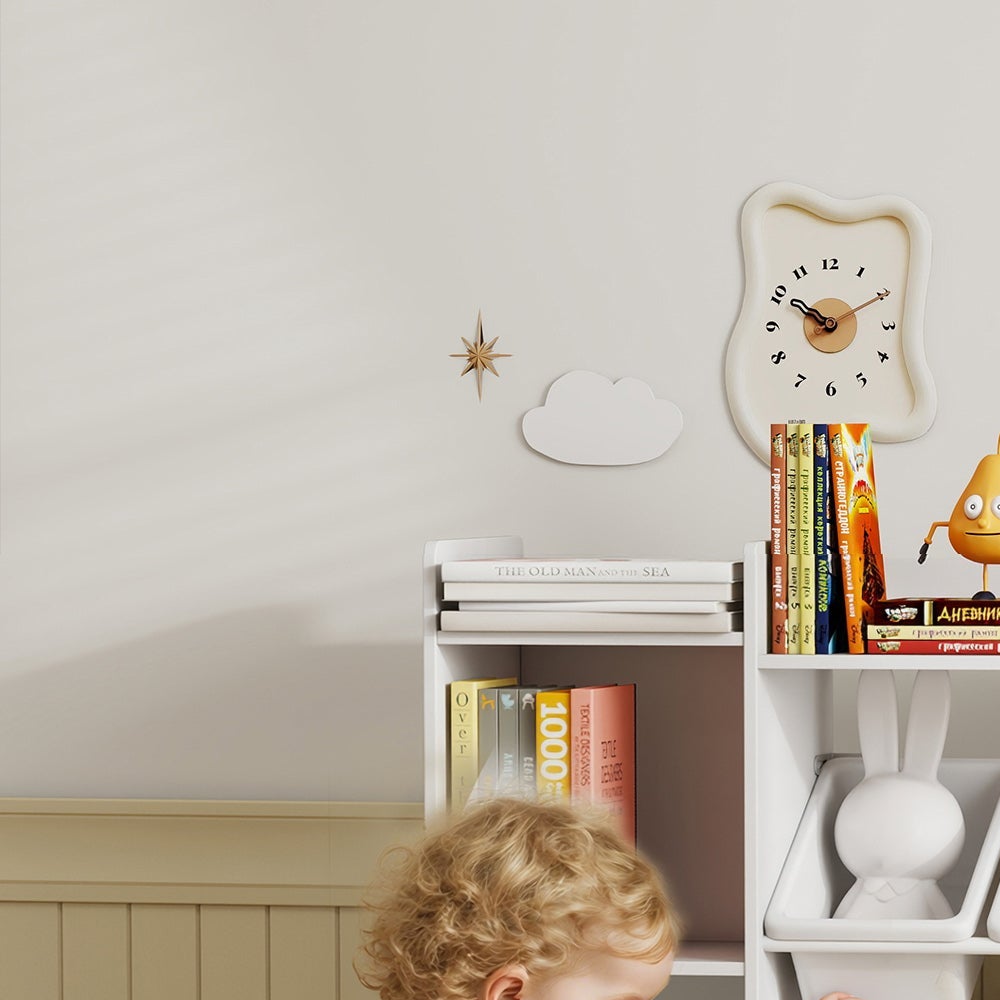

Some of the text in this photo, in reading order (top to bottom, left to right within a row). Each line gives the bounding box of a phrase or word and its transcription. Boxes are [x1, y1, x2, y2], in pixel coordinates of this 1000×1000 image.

[821, 258, 839, 270] 12
[792, 265, 808, 280] 11
[856, 266, 865, 278] 1
[771, 285, 787, 306] 10
[765, 321, 780, 332] 9
[881, 321, 896, 331] 3
[771, 351, 786, 365] 8
[877, 350, 889, 363] 4
[794, 373, 807, 388] 7
[855, 372, 867, 388] 5
[825, 381, 837, 397] 6
[816, 466, 824, 513] коллекция
[835, 461, 850, 534] СТРАННОГЕДДОН
[494, 566, 526, 577] THE
[528, 566, 561, 577] OLD
[564, 566, 597, 577] MAN
[599, 569, 618, 577] AND
[642, 566, 670, 577] SEA
[791, 602, 800, 610] 5
[580, 704, 590, 737] TEXTILE
[540, 702, 568, 780] 1000
